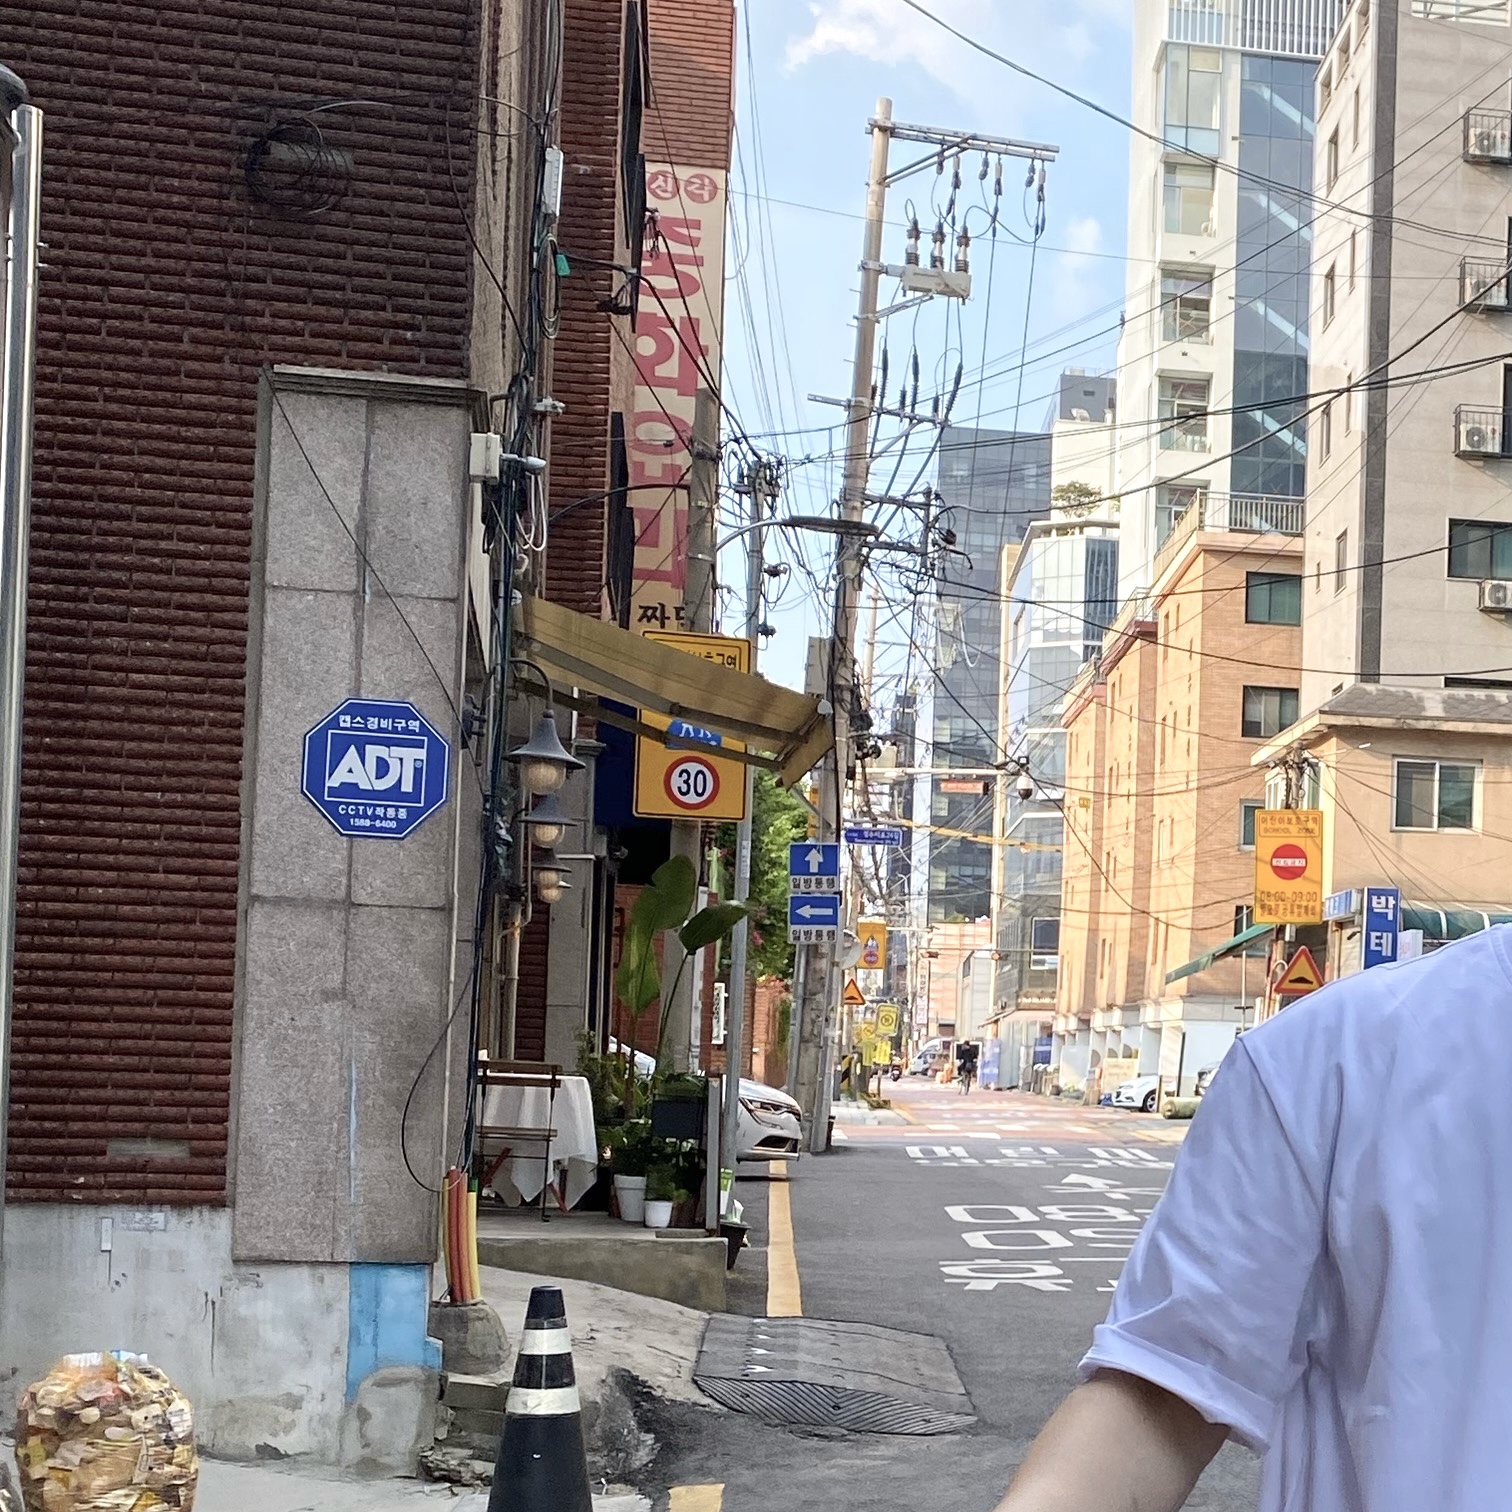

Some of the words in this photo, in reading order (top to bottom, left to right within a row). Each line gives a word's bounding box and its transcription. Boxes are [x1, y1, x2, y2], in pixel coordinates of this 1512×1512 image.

[338, 714, 421, 733] 캡스경비구역
[326, 743, 427, 793] ADT
[676, 768, 708, 798] 30
[791, 877, 836, 890] 일방통행
[791, 929, 836, 942] 일방통행
